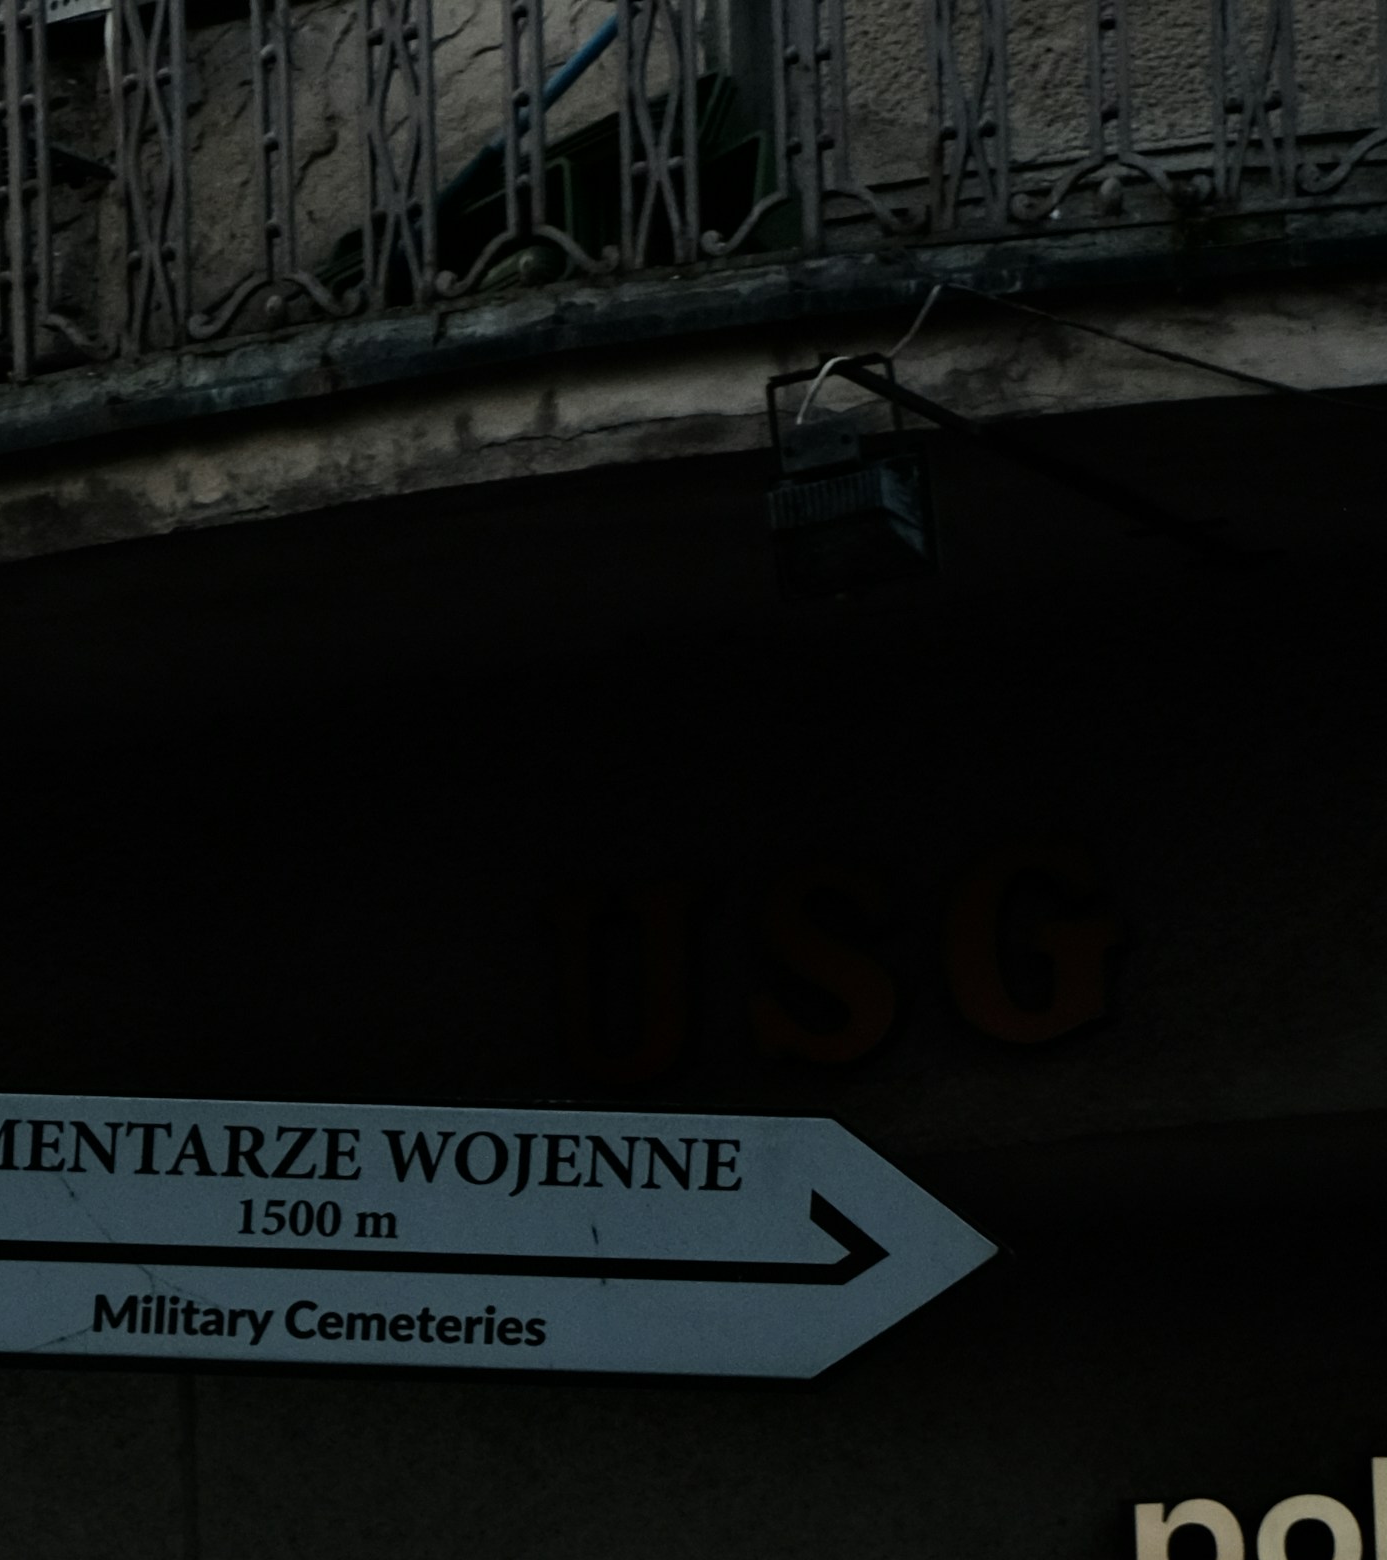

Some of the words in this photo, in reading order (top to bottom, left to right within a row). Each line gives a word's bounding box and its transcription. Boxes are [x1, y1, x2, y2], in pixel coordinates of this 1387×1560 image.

[537, 829, 1122, 1087] USG
[381, 1129, 743, 1198] WOJENNE
[237, 1198, 342, 1238] 1500
[354, 1211, 398, 1239] m
[92, 1294, 275, 1346] Military
[284, 1300, 547, 1347] Cemeteries
